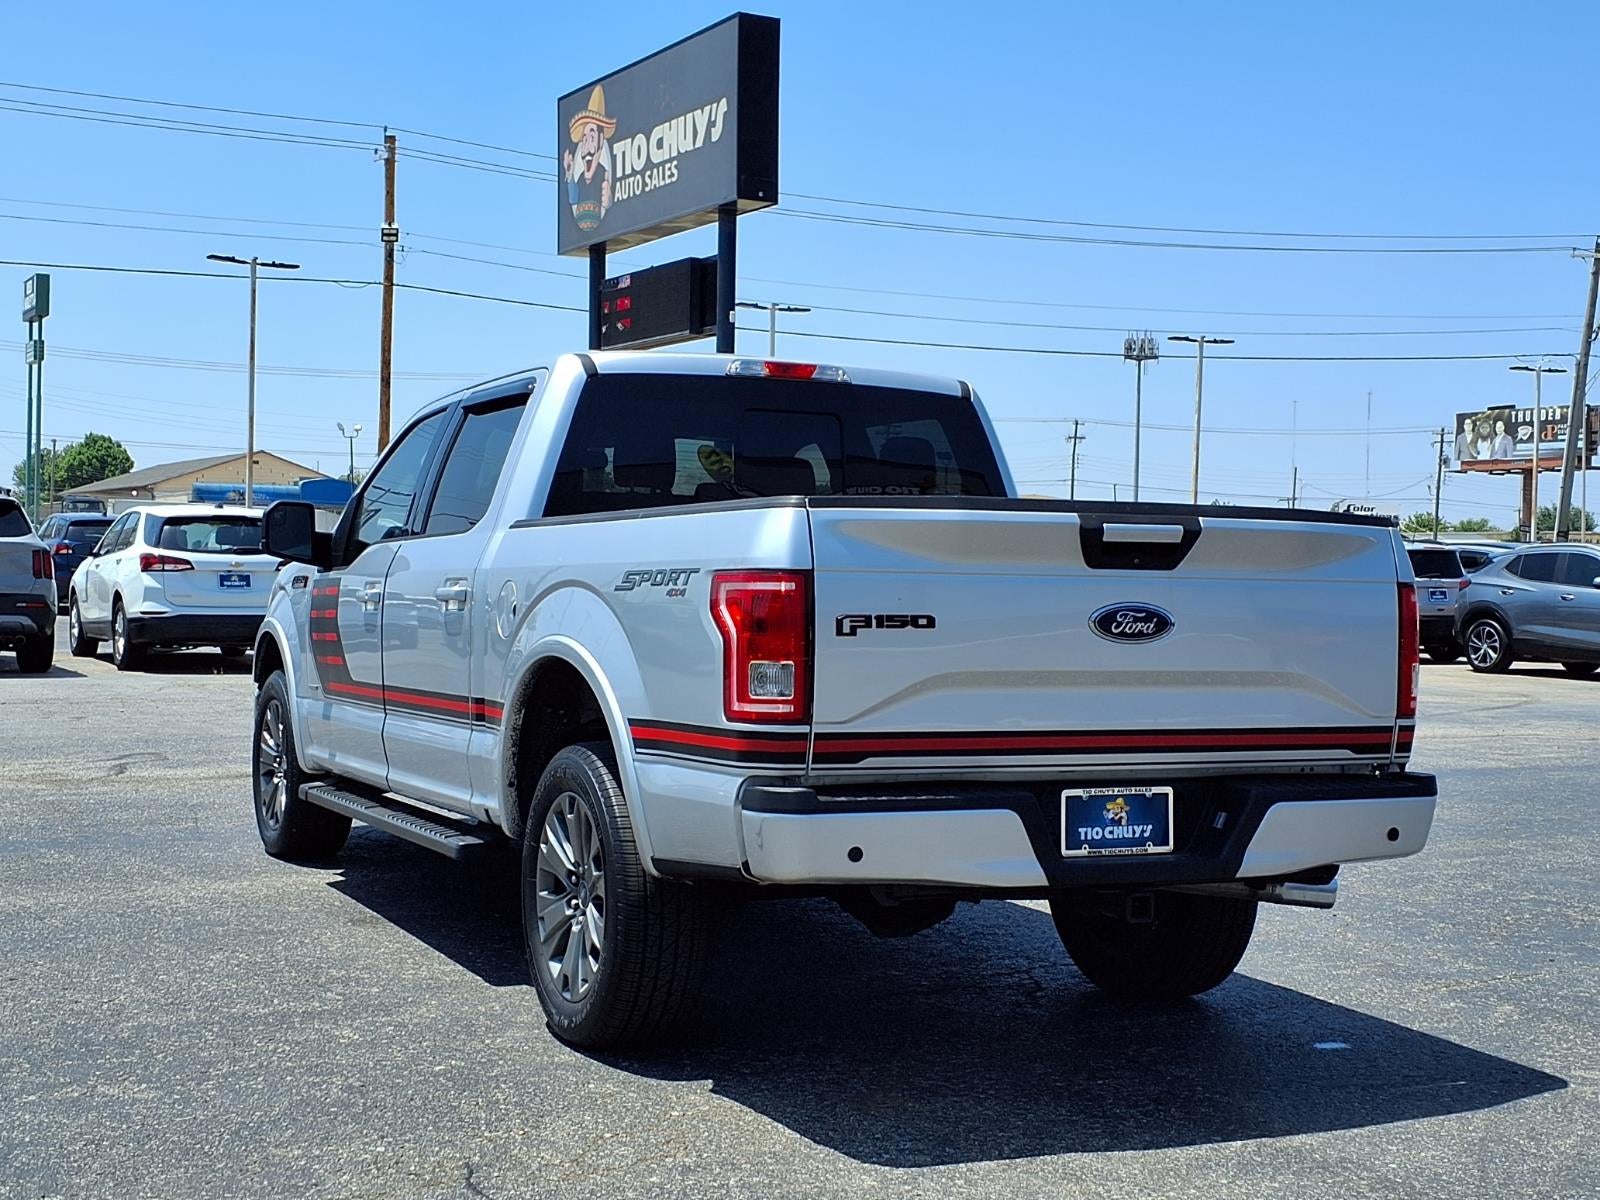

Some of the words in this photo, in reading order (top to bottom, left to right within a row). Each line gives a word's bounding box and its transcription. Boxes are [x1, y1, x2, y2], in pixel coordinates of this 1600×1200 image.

[613, 133, 648, 178] TIO
[649, 97, 728, 164] CHUY'S
[614, 175, 643, 202] AUTO
[644, 160, 678, 192] SALES
[1511, 408, 1561, 422] THUDER
[614, 567, 701, 592] SPORT
[1111, 611, 1157, 634] Ford
[1078, 826, 1103, 840] TIO
[1104, 824, 1153, 839] CHUY'S
